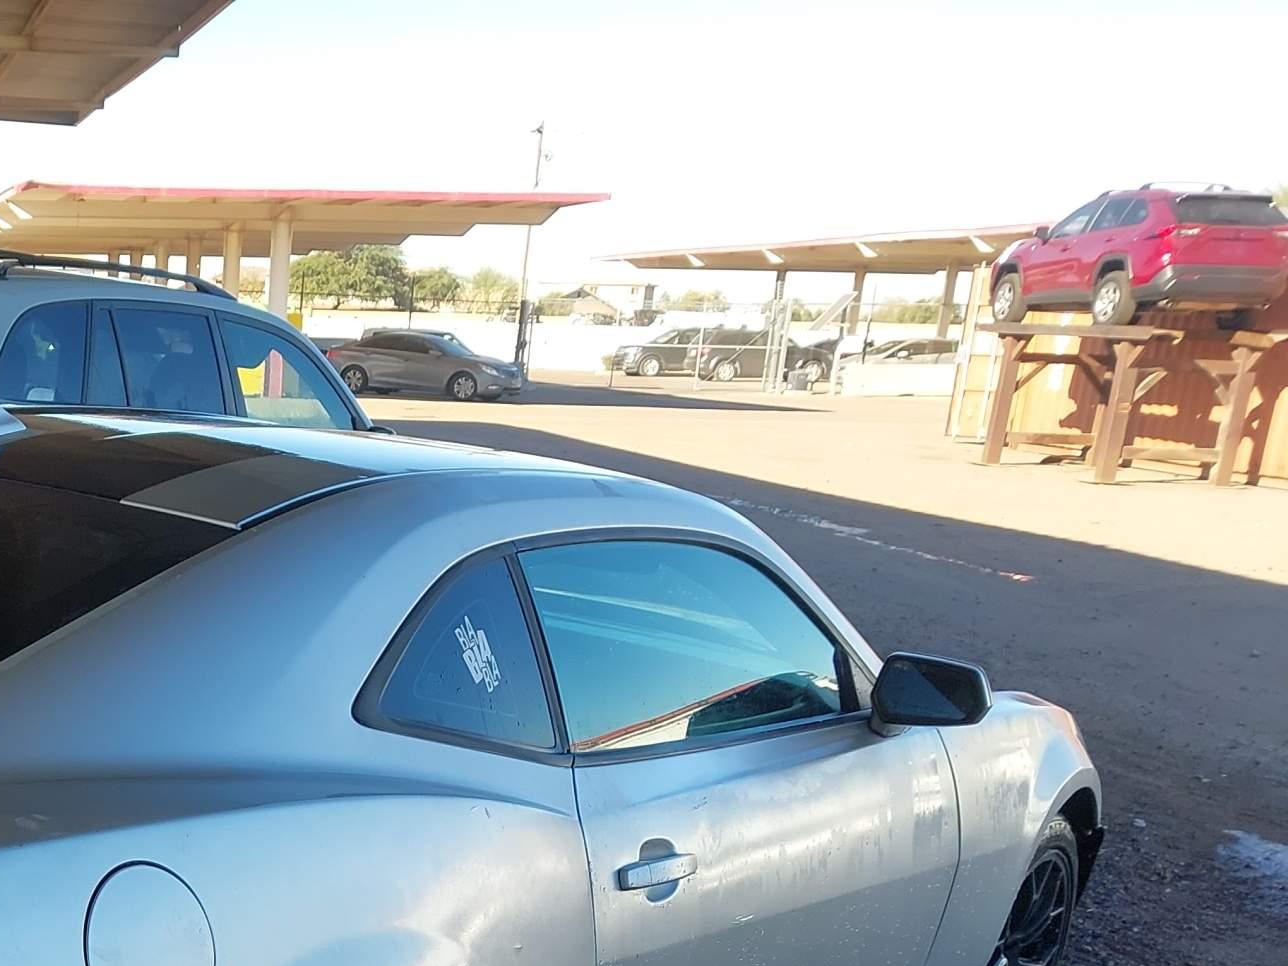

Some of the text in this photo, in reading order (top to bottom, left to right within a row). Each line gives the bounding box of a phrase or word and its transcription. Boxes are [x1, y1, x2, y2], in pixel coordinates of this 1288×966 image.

[454, 615, 479, 650] BLA
[462, 629, 492, 684] BLA
[481, 654, 502, 693] BLA
